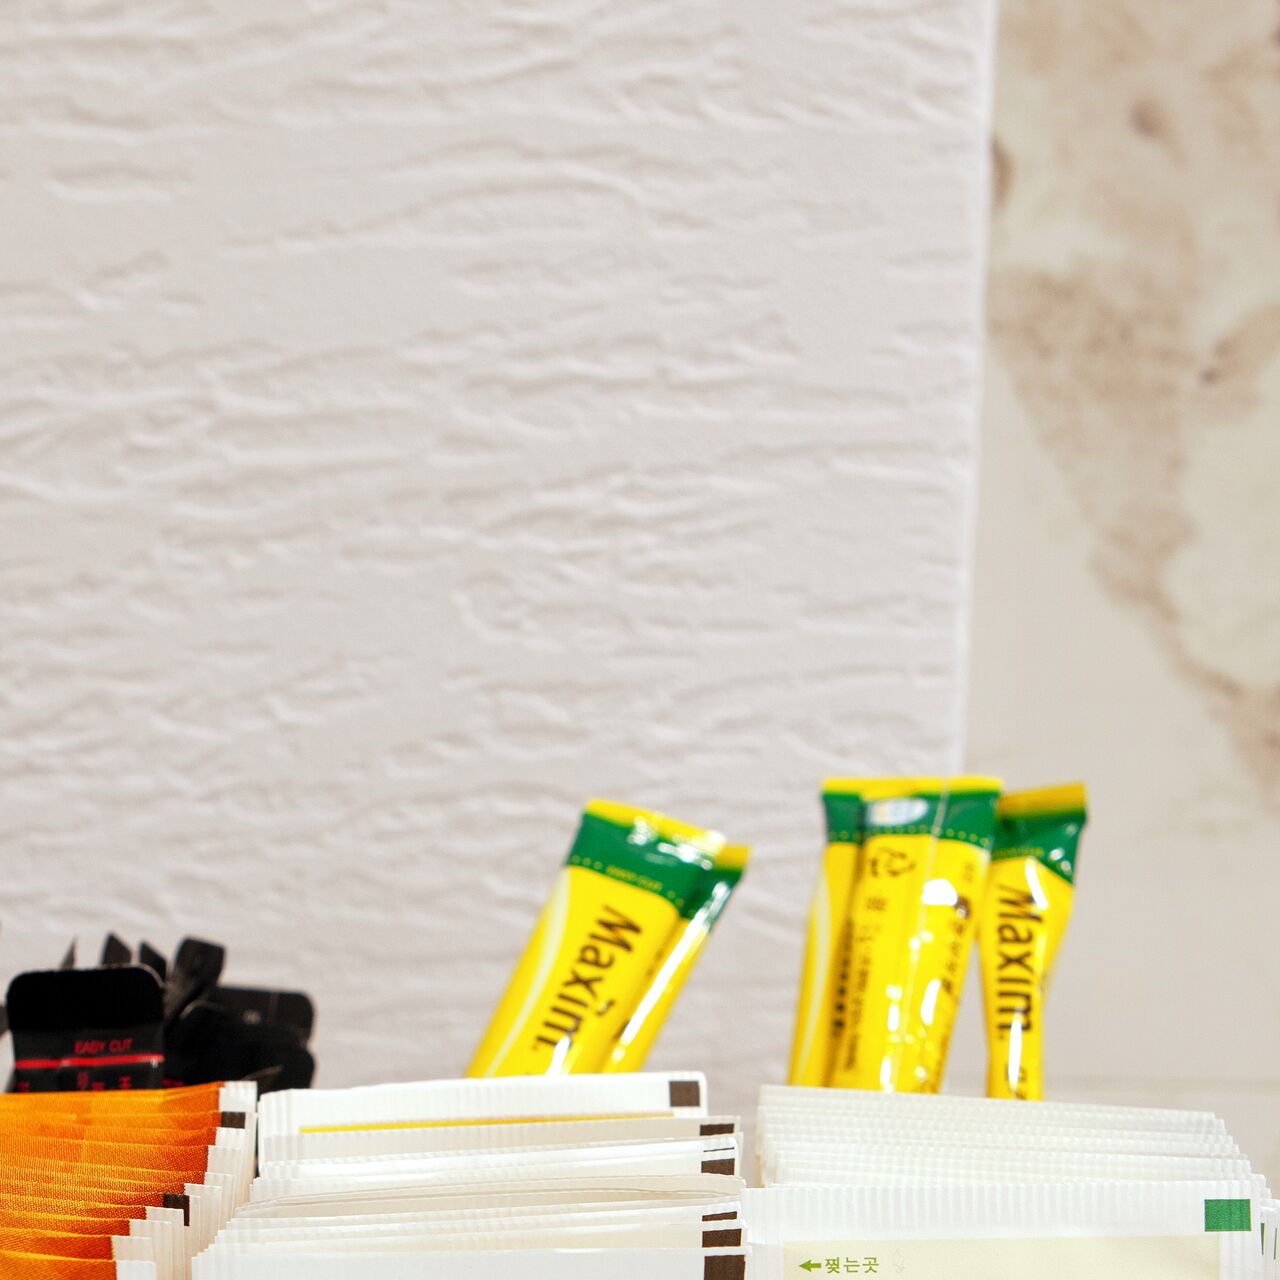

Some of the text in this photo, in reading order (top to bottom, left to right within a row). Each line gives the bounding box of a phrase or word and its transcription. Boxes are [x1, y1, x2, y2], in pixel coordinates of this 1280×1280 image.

[535, 904, 643, 1048] Maxim
[997, 884, 1042, 1031] Maxim
[825, 1256, 880, 1275] 찢는곳
